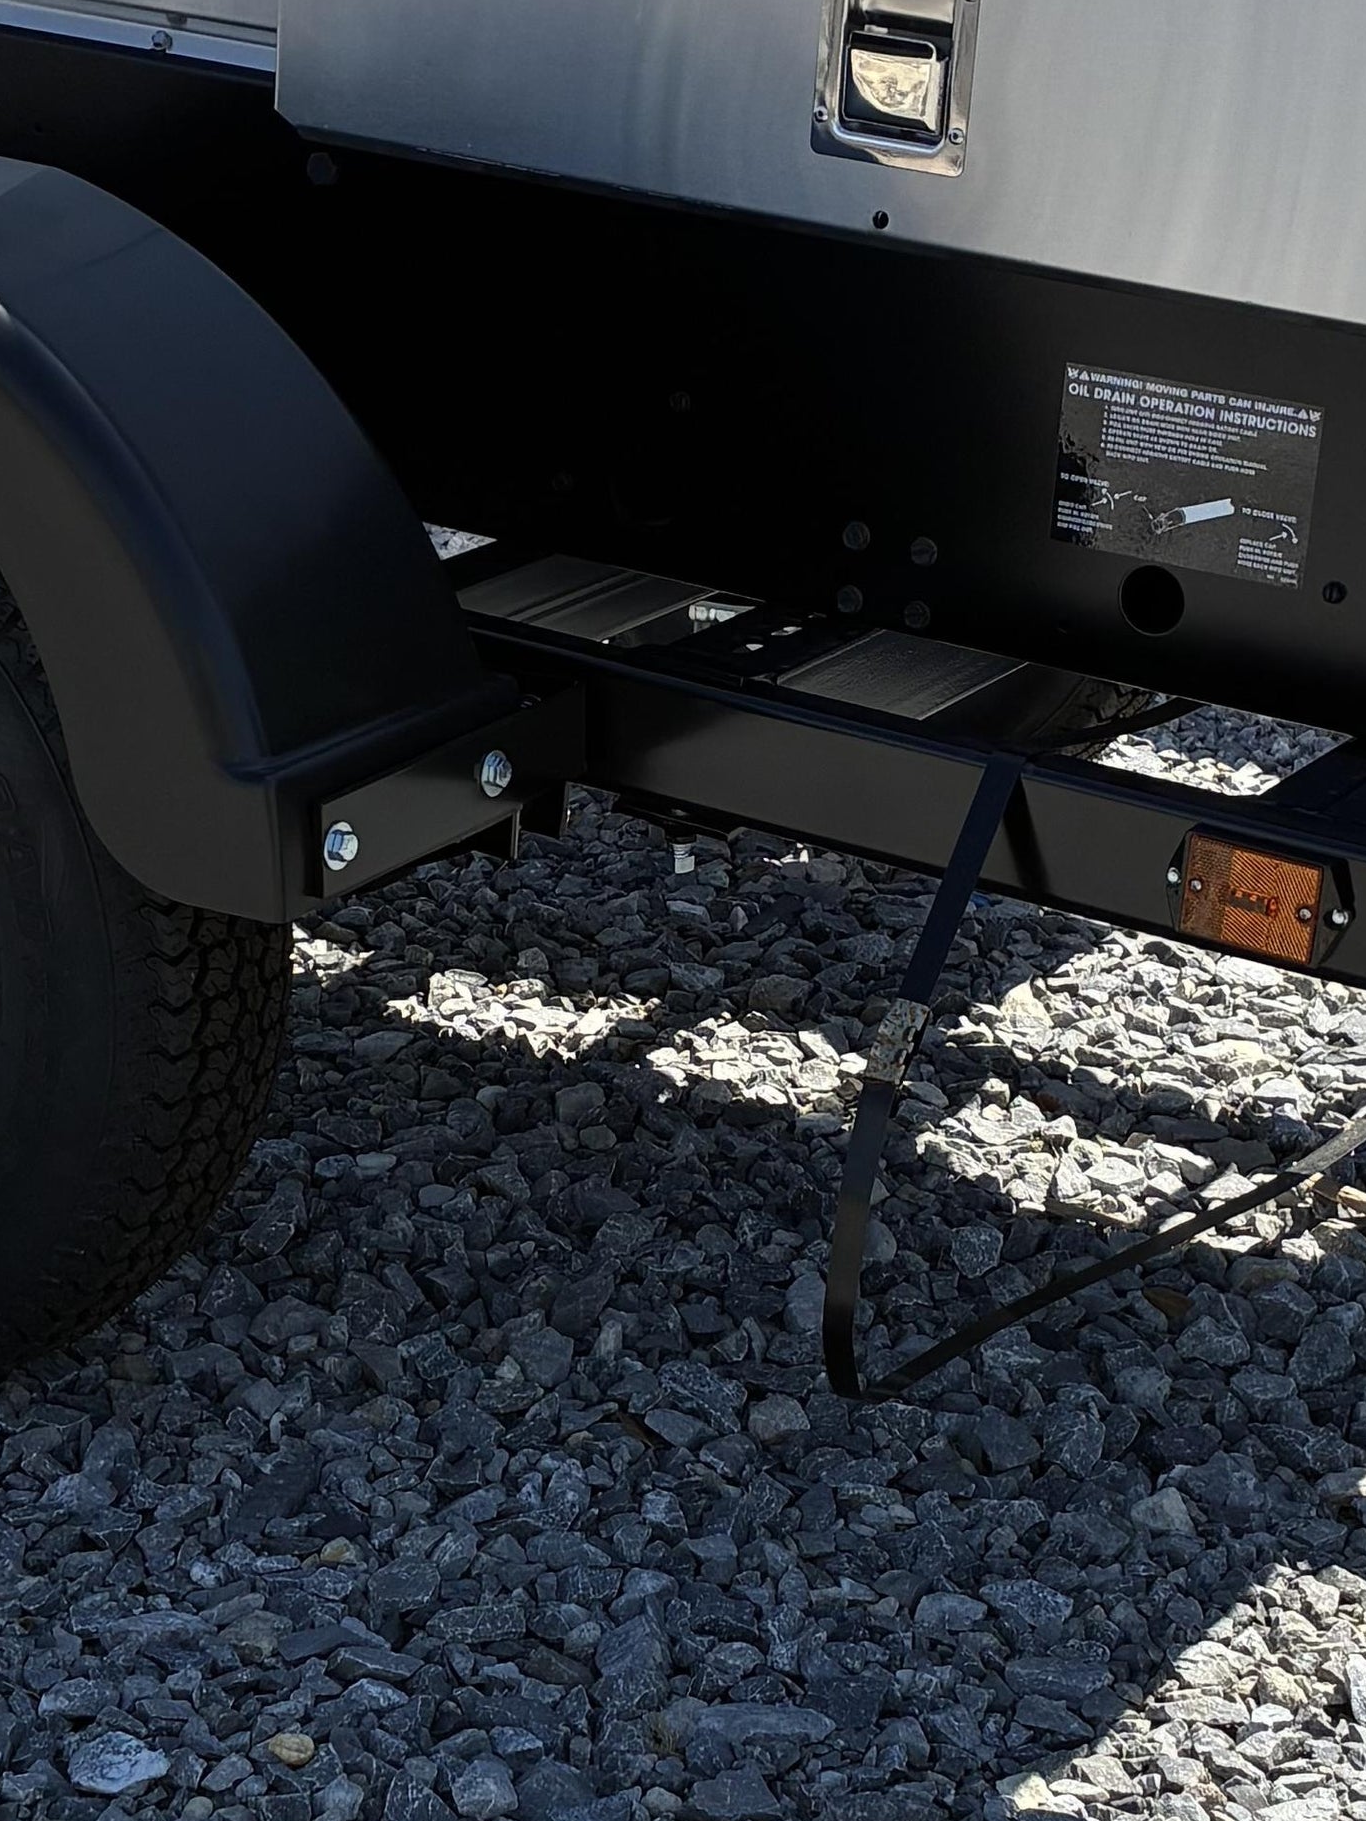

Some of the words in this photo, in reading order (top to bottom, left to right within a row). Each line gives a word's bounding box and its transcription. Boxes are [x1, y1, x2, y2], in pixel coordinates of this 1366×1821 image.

[1068, 382, 1090, 398] OIL
[1094, 387, 1135, 406] DRAIN
[1139, 395, 1215, 420] OPERATION
[1219, 409, 1317, 438] INSTRUCTIONS
[1090, 372, 1143, 390] WARNING!
[1146, 382, 1188, 397] MOVING
[1190, 390, 1226, 405] PARTS
[1229, 397, 1252, 410] CAN
